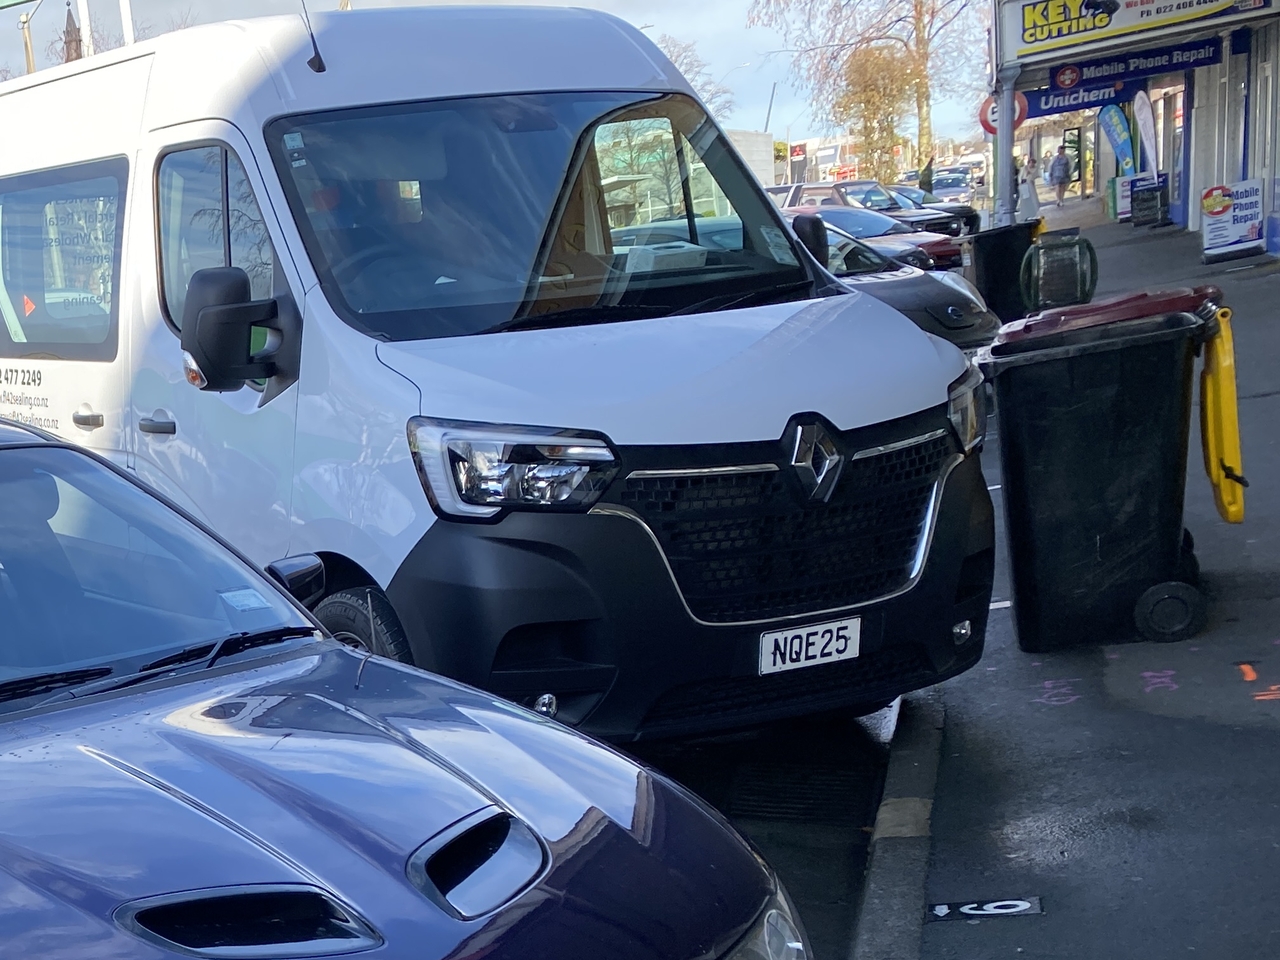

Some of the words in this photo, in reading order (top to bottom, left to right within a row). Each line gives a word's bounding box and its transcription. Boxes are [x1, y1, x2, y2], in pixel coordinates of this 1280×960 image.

[1024, 0, 1083, 28] KEY
[1156, 4, 1174, 14] 022
[1024, 13, 1110, 42] CUTTING
[1082, 62, 1125, 79] Mobile
[1129, 54, 1169, 71] Phone
[1172, 46, 1214, 64] Repair
[1040, 87, 1116, 110] Unichem
[1232, 187, 1260, 200] Mobile
[1232, 200, 1259, 213] Phone
[1232, 211, 1260, 224] Repair
[4, 368, 18, 385] 477
[21, 370, 42, 386] 2249
[772, 626, 849, 667] NQE25
